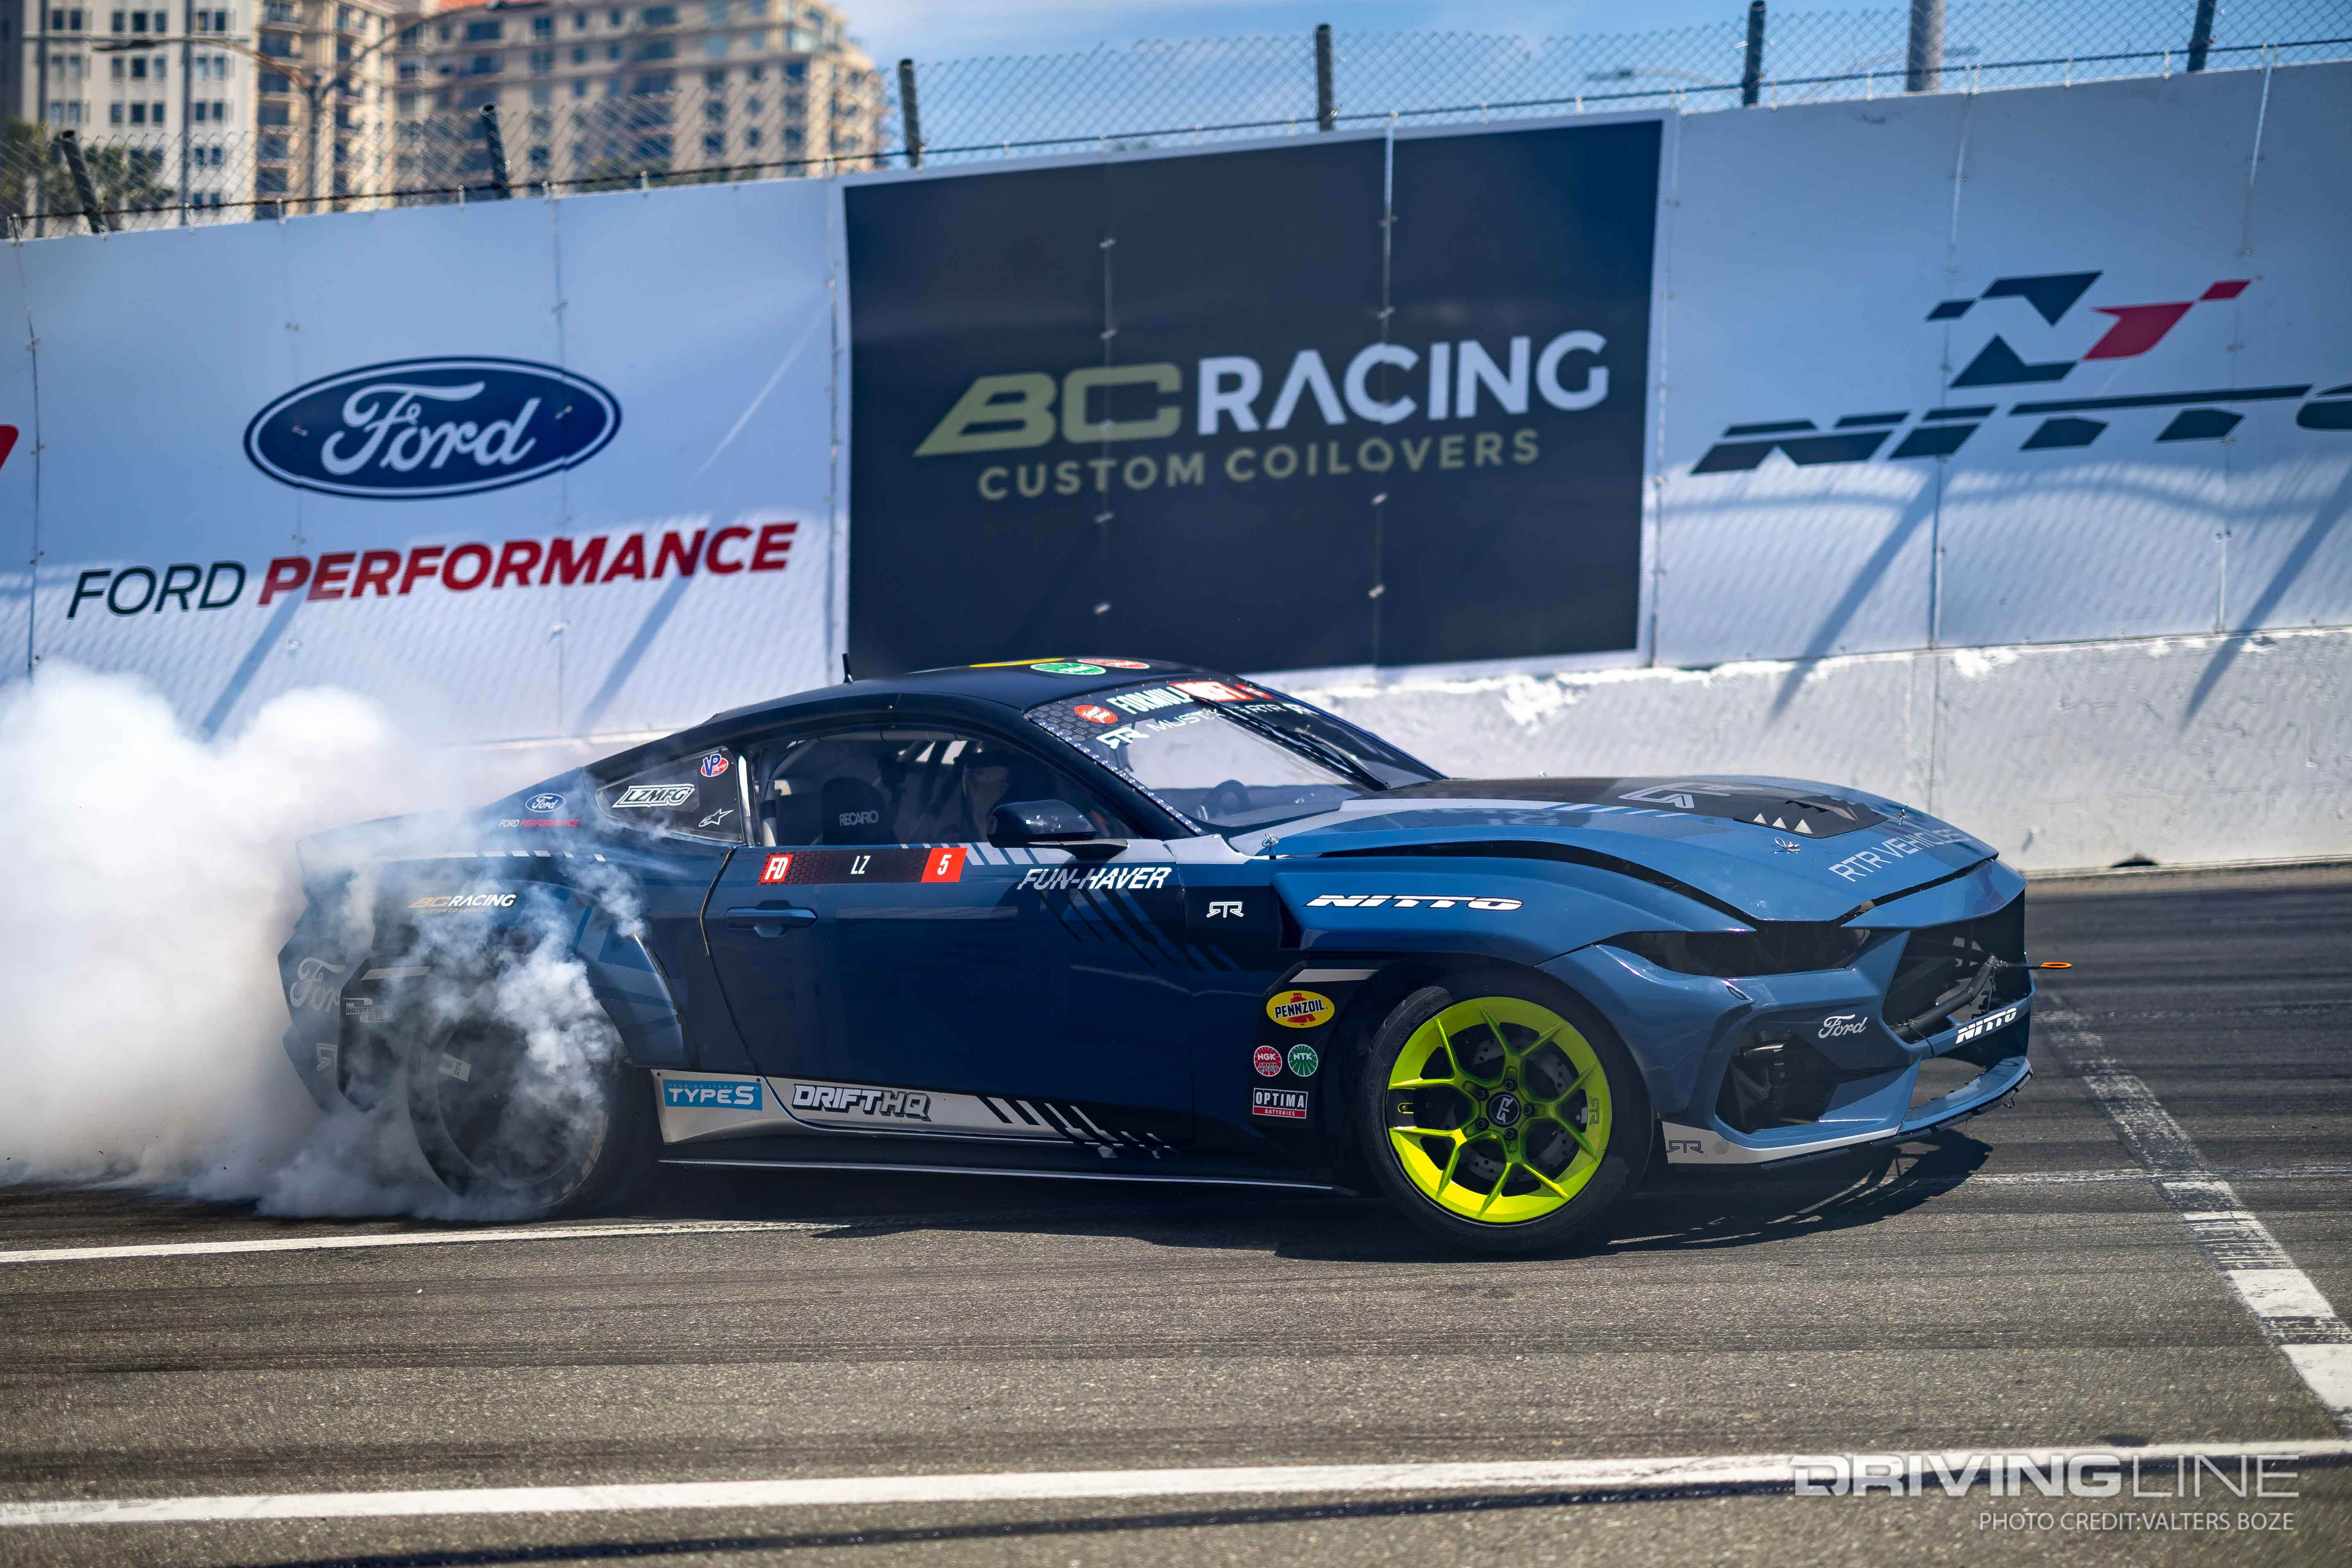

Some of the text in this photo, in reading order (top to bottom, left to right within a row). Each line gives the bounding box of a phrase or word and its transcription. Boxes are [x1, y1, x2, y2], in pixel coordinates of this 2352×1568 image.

[1198, 331, 1608, 435] RACING
[322, 382, 540, 475] Ford
[979, 429, 1539, 499] CUSTOM COILOVERS
[67, 522, 799, 619] FORD PERFORMANCE
[703, 754, 721, 777] VP
[532, 796, 558, 809] Ford
[840, 810, 878, 826] RECARO
[764, 854, 952, 880] FD LZ 5
[1828, 829, 1971, 882] RTR VEHICLES
[1017, 867, 1172, 890] FUN-HAVER
[448, 894, 517, 907] RACING
[1305, 895, 1524, 911] NITTO
[1274, 998, 1325, 1019] PENNZOIL
[1818, 1014, 1868, 1039] Ford
[1956, 1007, 2017, 1044] NITTO
[1256, 1092, 1305, 1108] OPTIMA
